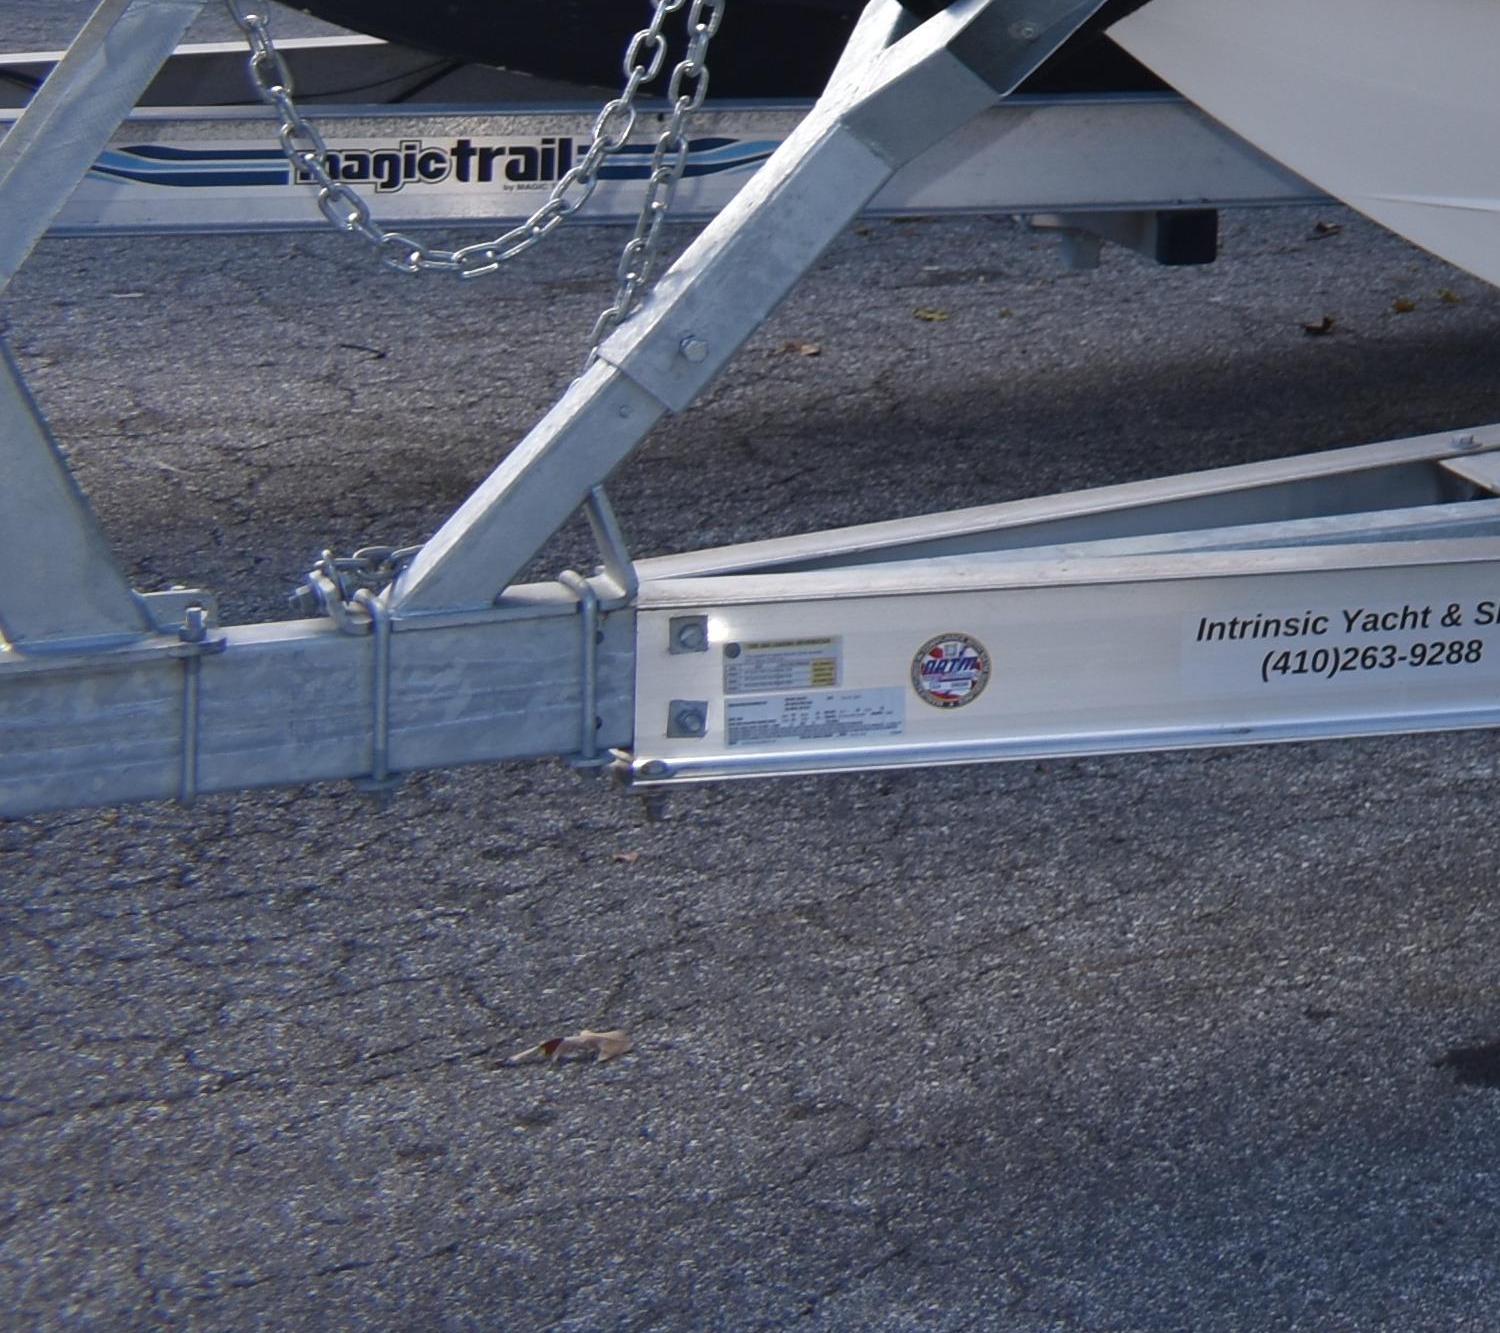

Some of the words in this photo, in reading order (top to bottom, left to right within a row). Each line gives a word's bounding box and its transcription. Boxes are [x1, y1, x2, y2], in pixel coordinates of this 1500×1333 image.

[1196, 613, 1330, 642] Intrinsic
[1342, 605, 1433, 634] Yacht
[1440, 603, 1463, 628] &
[1261, 639, 1485, 683] (410)263-9288
